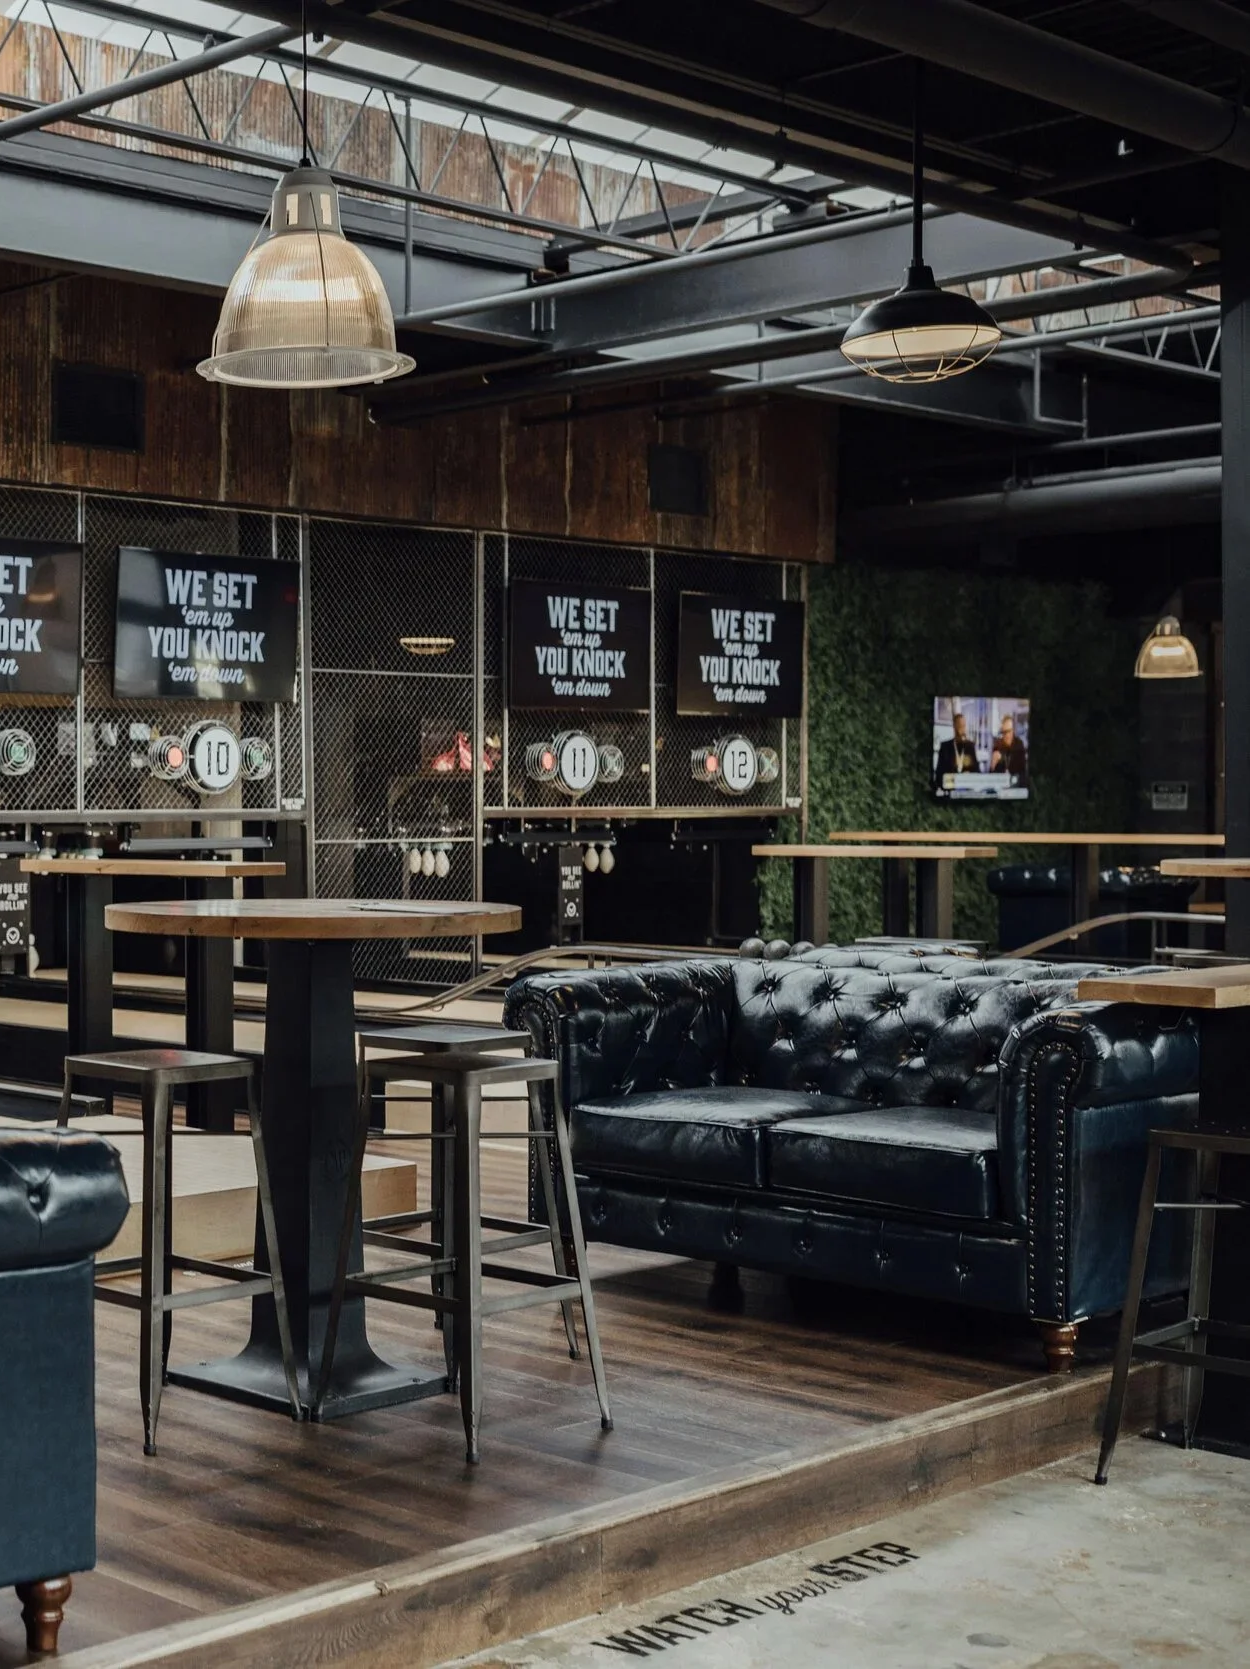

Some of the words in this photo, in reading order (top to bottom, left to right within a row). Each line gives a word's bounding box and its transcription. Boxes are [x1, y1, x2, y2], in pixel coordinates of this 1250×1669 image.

[165, 568, 207, 606] WE
[213, 572, 257, 609] SET
[181, 605, 210, 626] 'em
[212, 612, 235, 630] up
[547, 596, 580, 629] WE
[584, 599, 619, 632] SET
[711, 608, 741, 640] WE
[743, 611, 775, 643] SET
[148, 626, 190, 659] YOU
[196, 628, 265, 663] KNOCK
[584, 633, 602, 649] up
[743, 643, 760, 659] up
[168, 661, 198, 682] 'em
[199, 663, 245, 684] down
[535, 646, 568, 676] YOU
[572, 648, 626, 678] KNOCK
[699, 655, 729, 682] YOU
[732, 657, 781, 686] KNOCK
[575, 678, 611, 697] down
[735, 685, 767, 704] down
[206, 741, 230, 776] 10
[572, 748, 586, 777] 11
[731, 751, 748, 778] 12
[14, 882, 28, 894] SEE
[589, 1598, 766, 1657] WATCH
[755, 1578, 842, 1615] your
[808, 1541, 921, 1582] STEP
